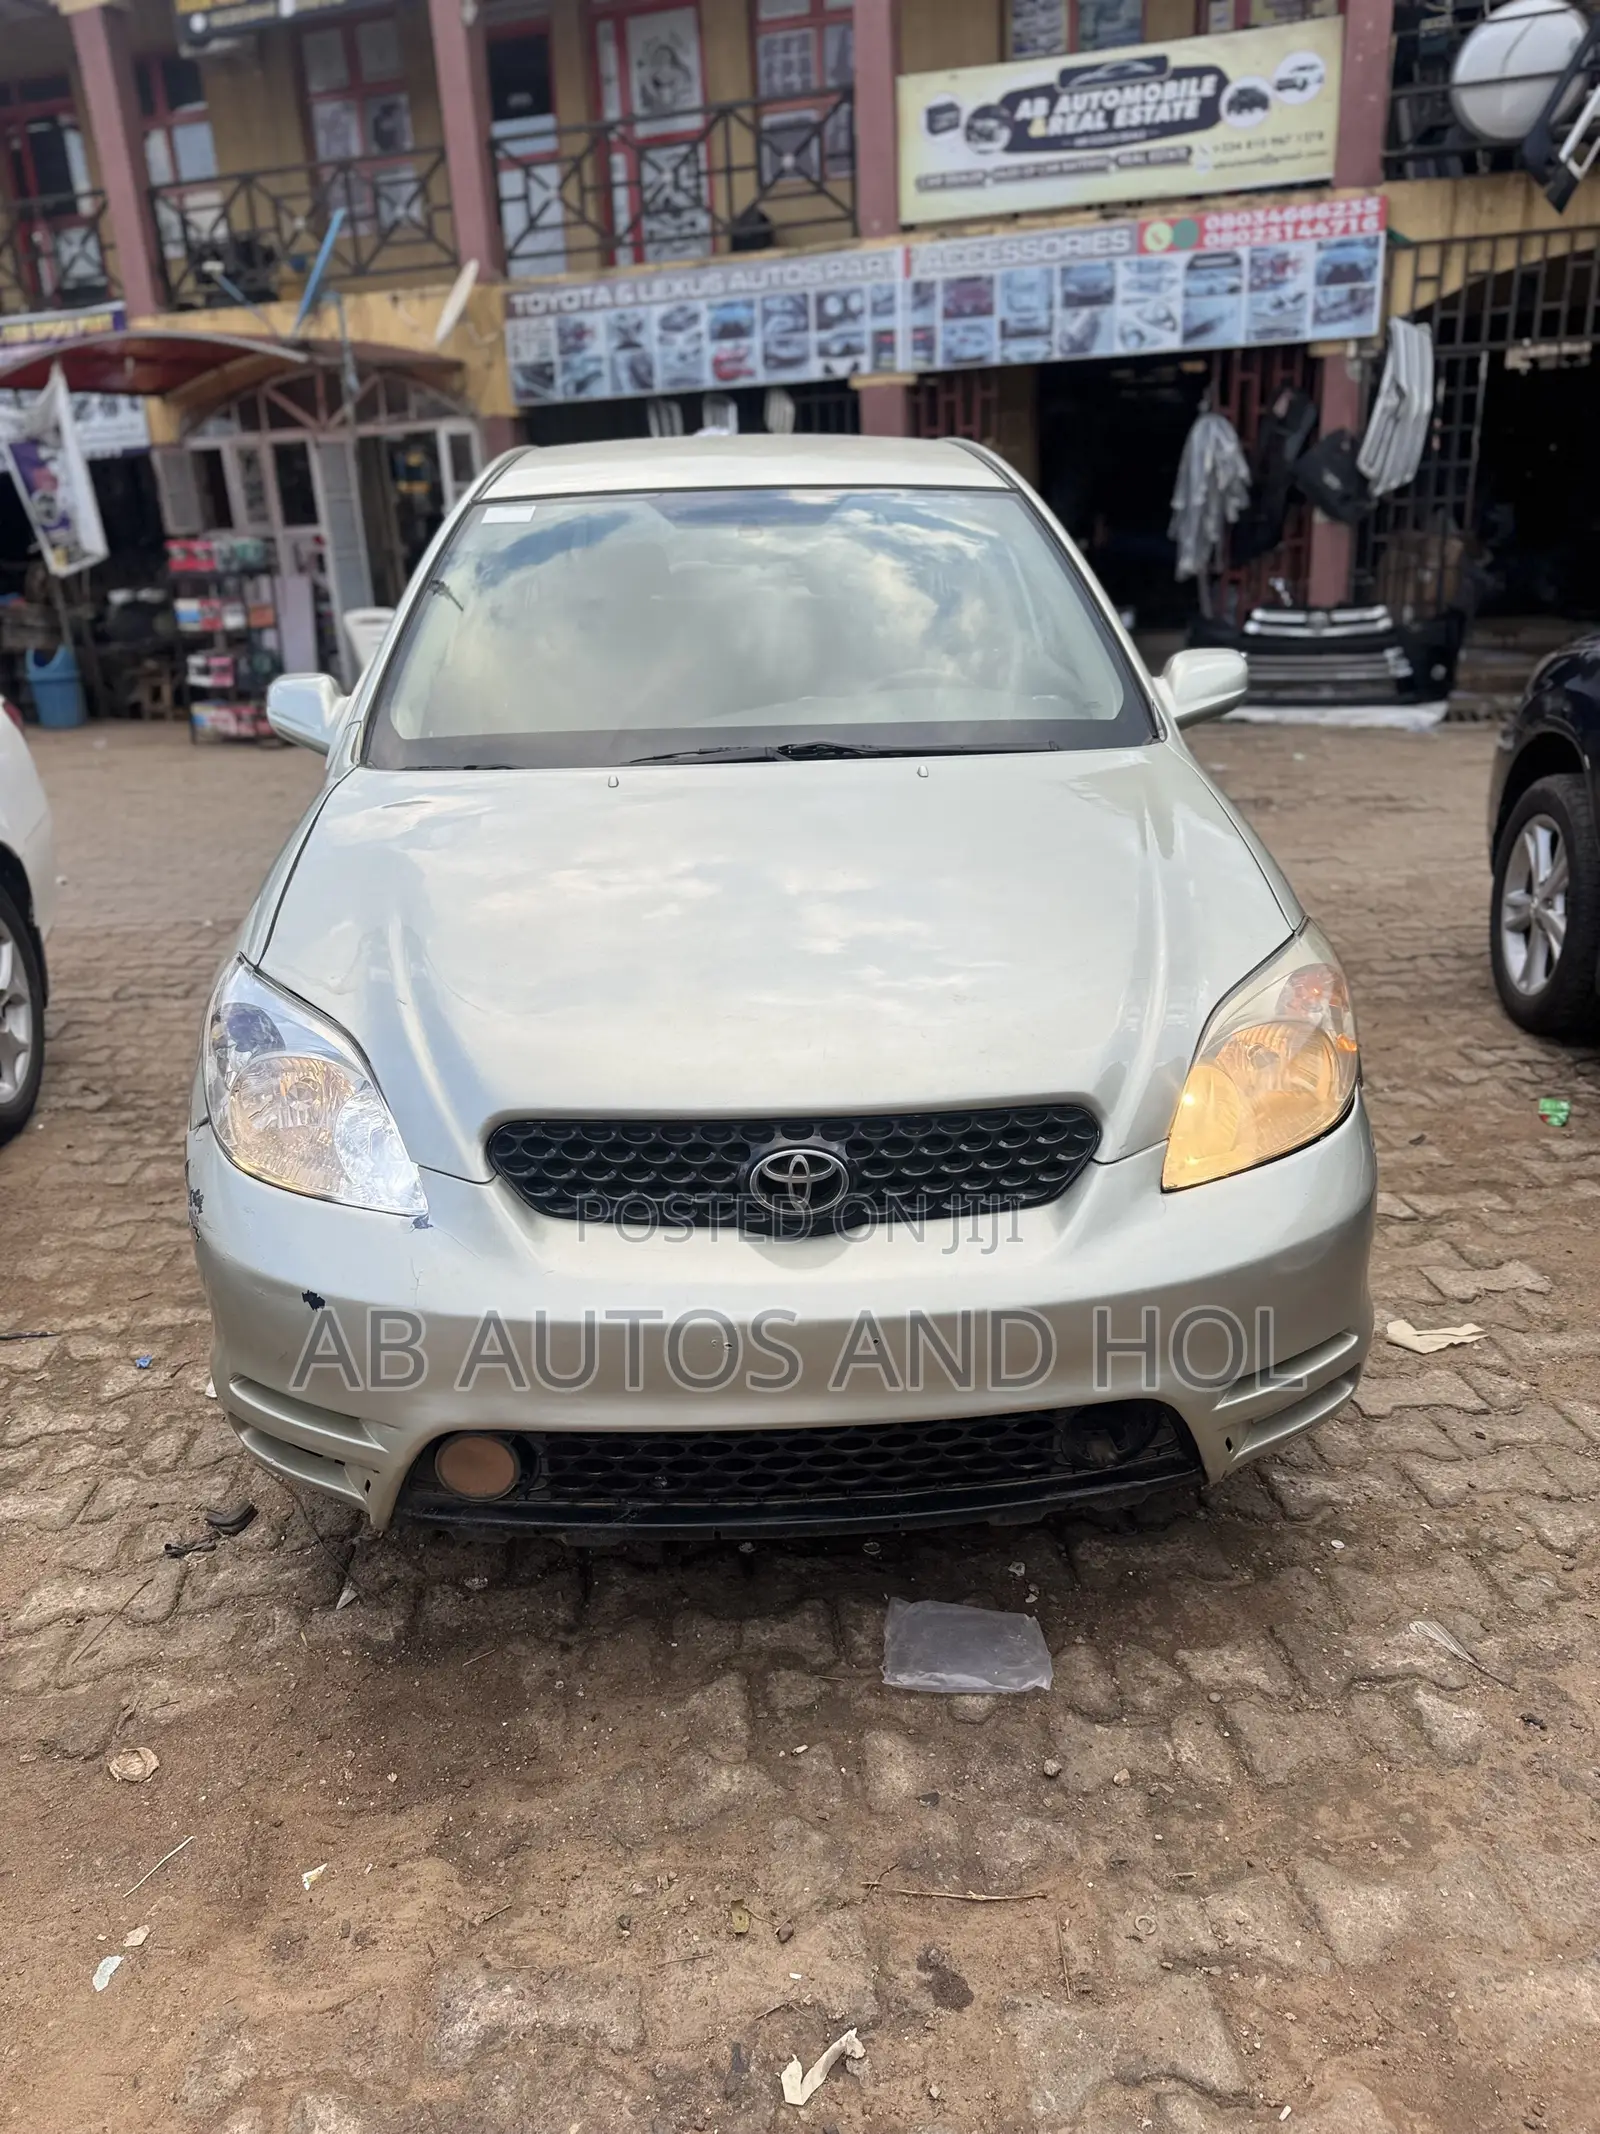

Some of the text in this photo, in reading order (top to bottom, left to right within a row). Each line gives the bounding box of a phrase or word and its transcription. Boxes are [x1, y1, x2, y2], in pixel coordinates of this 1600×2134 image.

[1014, 74, 1219, 122] AB AUTOMOBILE
[1046, 108, 1109, 137] REAL
[1113, 98, 1203, 129] ESTATE
[917, 228, 1131, 275] ACCESSORIES
[509, 285, 613, 318] TOYOTA
[637, 271, 725, 304] LEXUS
